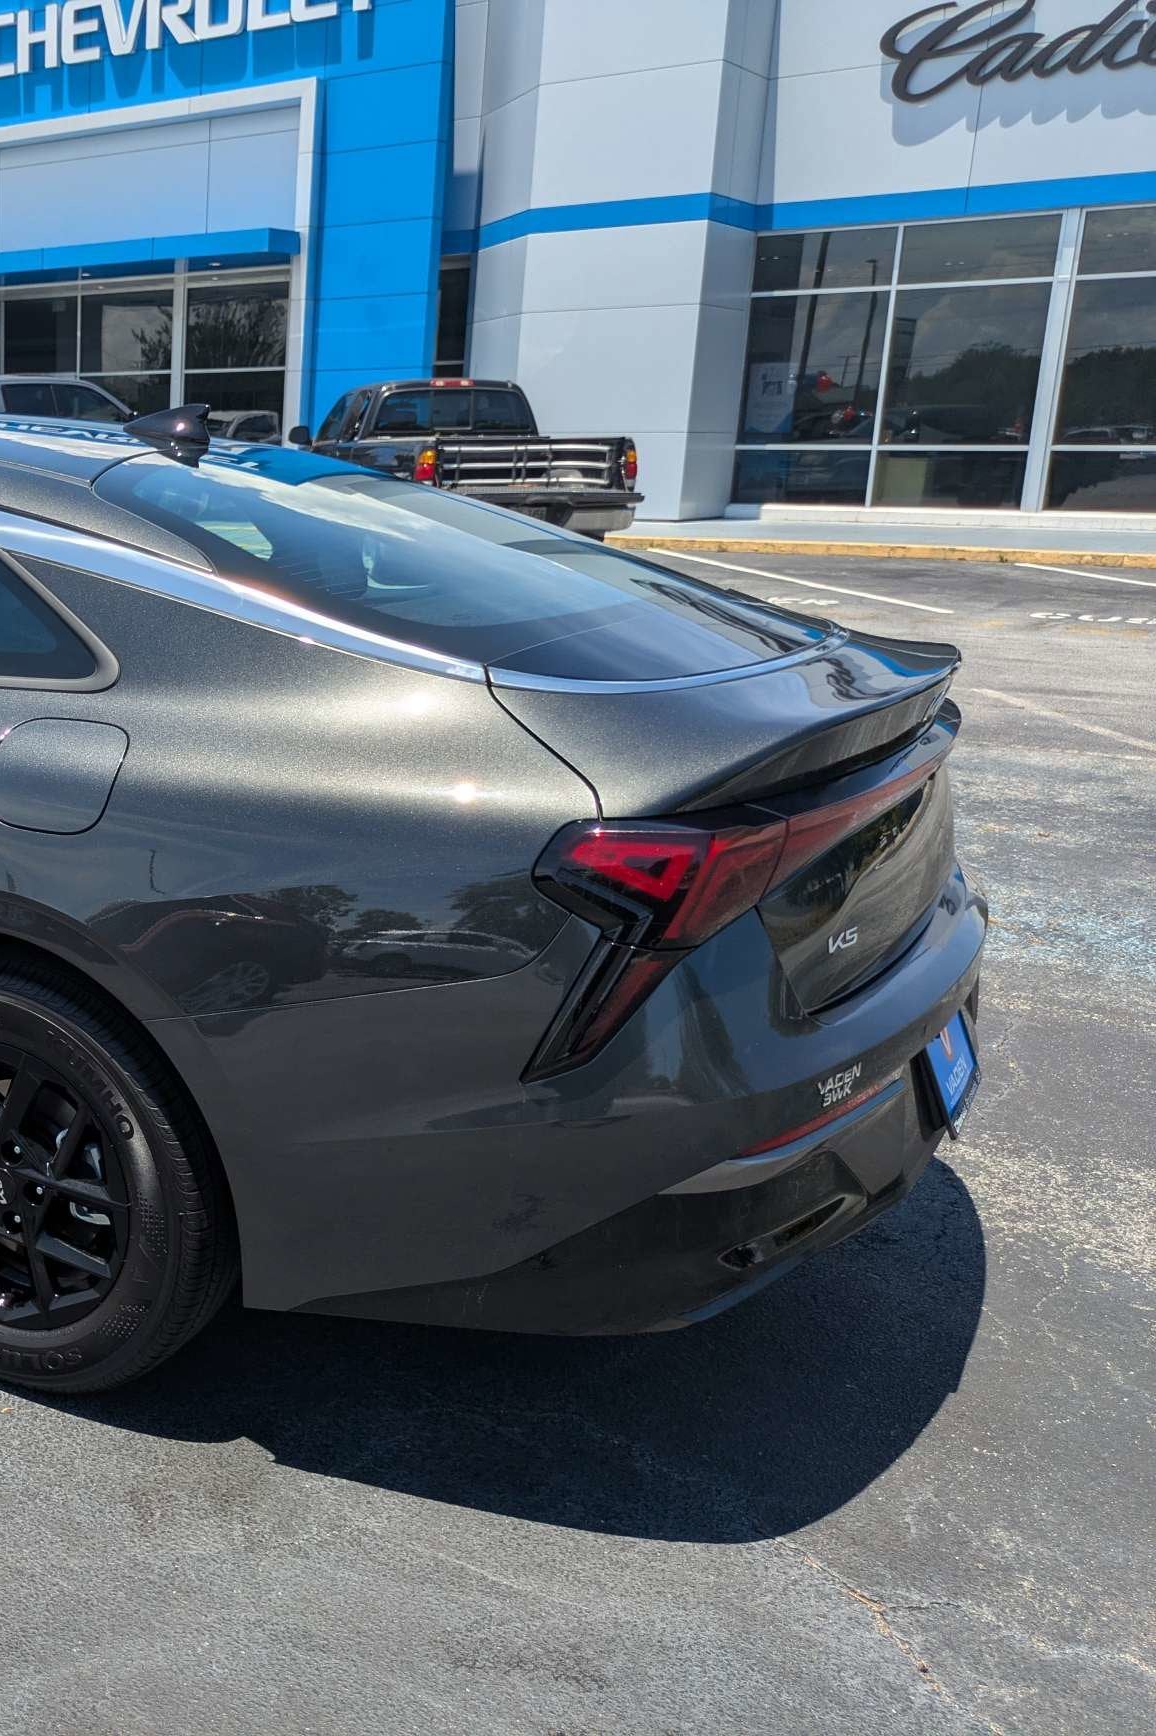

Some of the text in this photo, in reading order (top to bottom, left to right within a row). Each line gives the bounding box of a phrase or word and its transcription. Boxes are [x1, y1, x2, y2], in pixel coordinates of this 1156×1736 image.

[828, 926, 859, 954] K5
[817, 1061, 862, 1095] VADEN
[945, 1053, 968, 1096] VADEN
